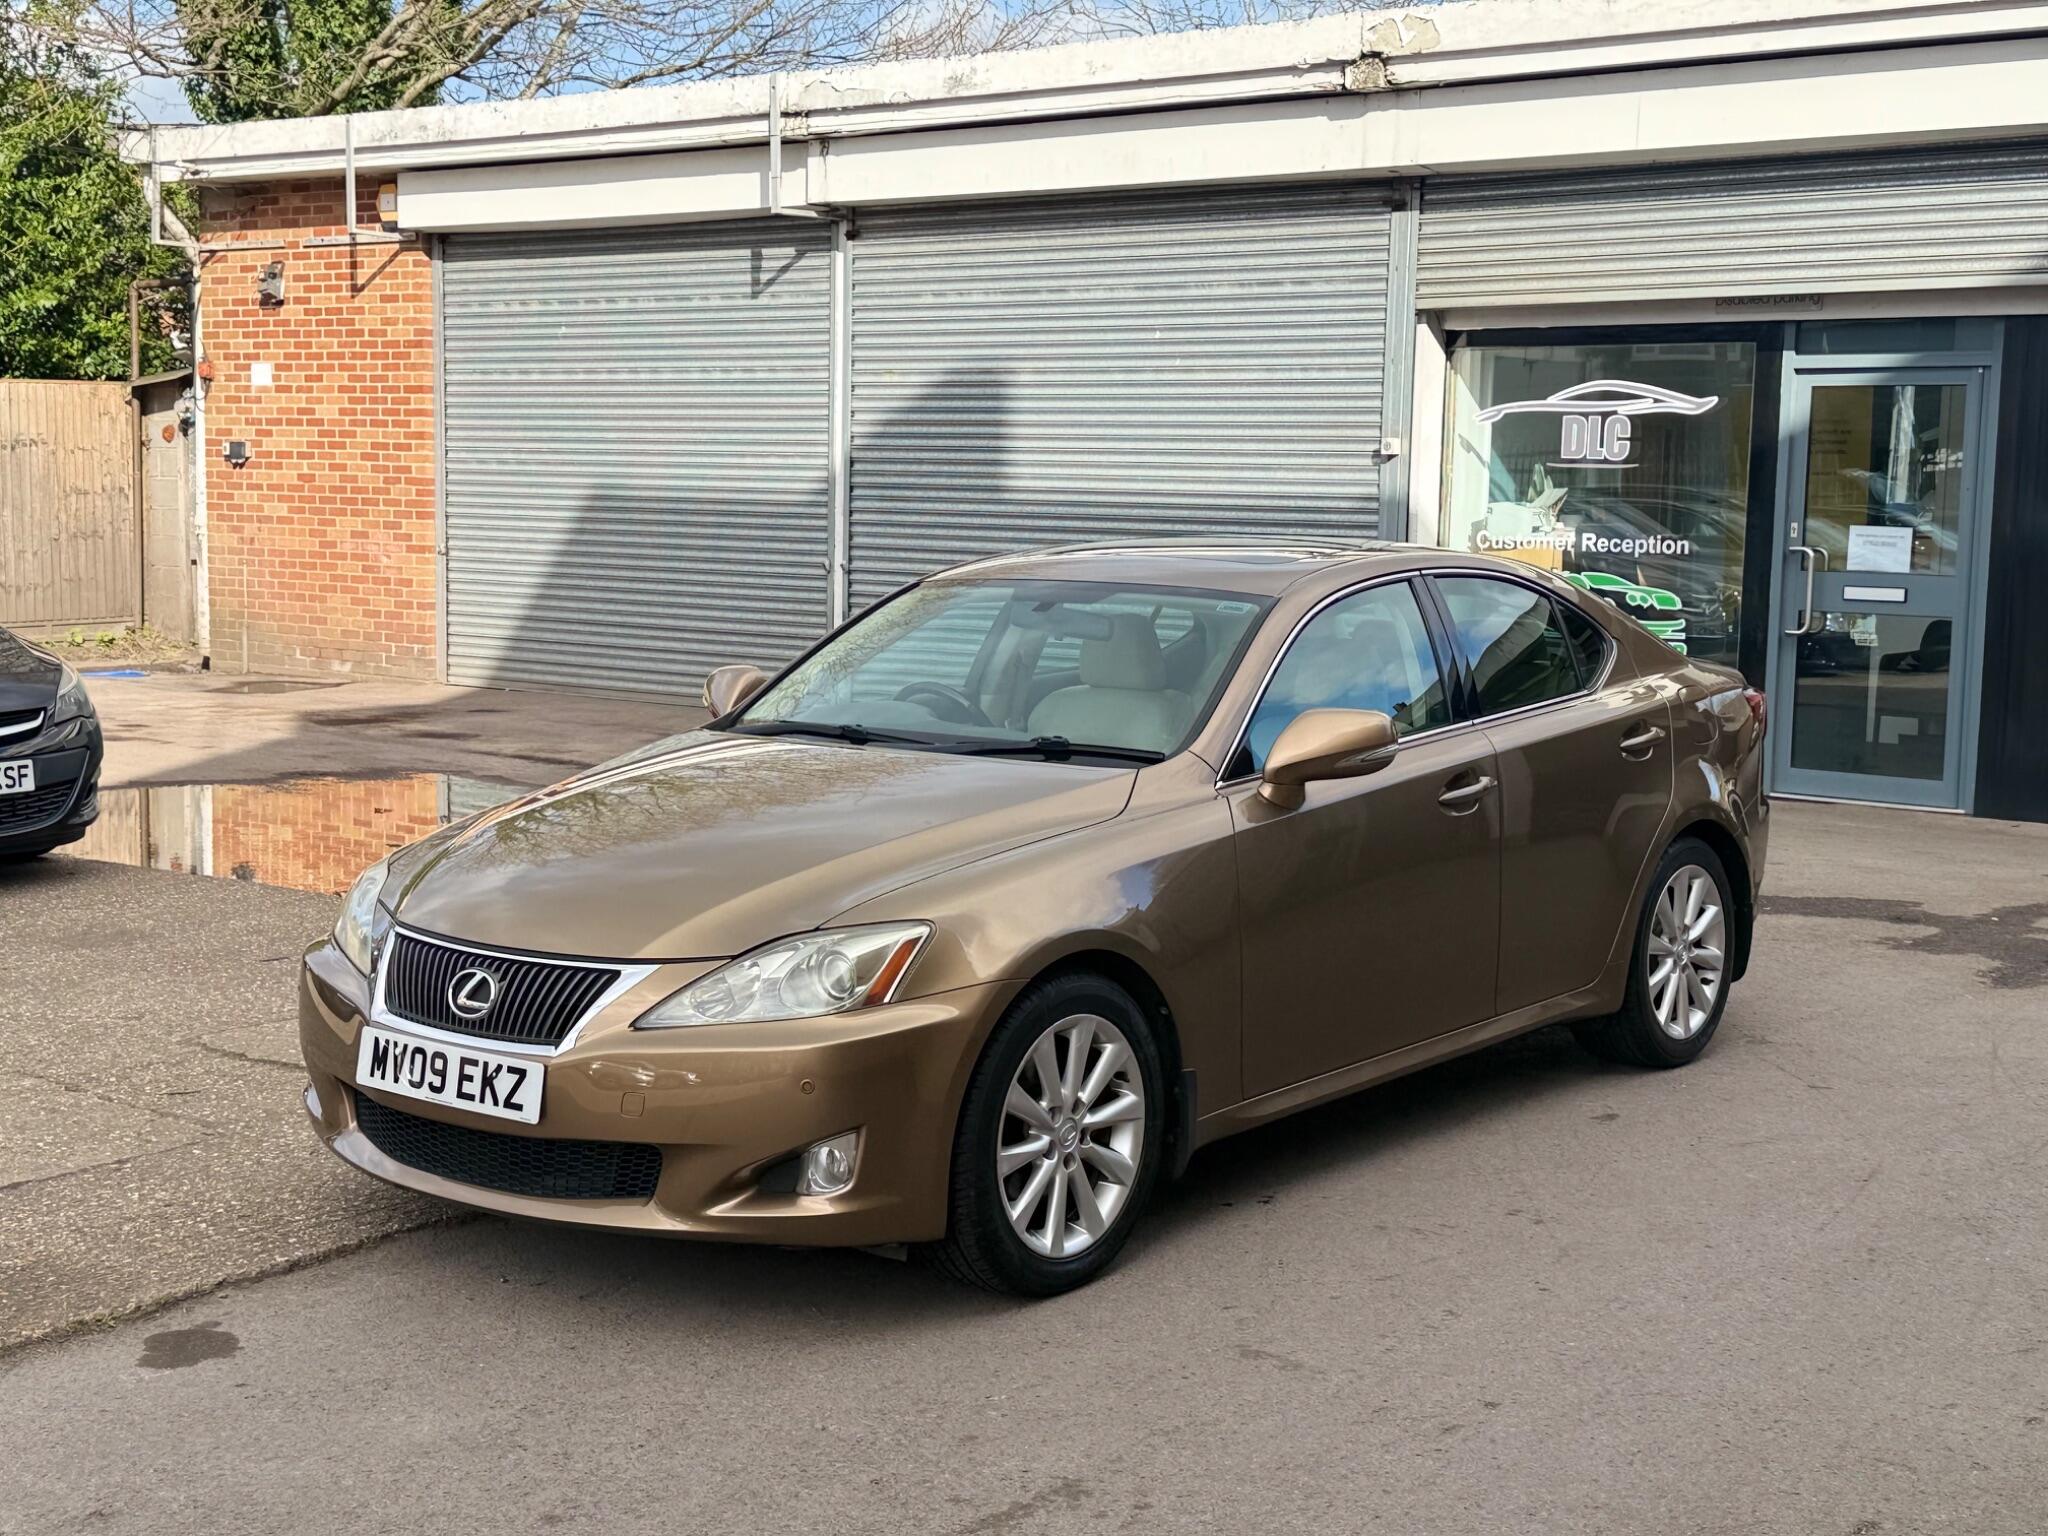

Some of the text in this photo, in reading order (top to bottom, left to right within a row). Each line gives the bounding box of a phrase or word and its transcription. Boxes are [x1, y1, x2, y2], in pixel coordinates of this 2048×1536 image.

[1560, 414, 1632, 461] DLC
[1476, 530, 1690, 558] Customer Reception
[369, 1035, 528, 1113] MV09 EKZ
